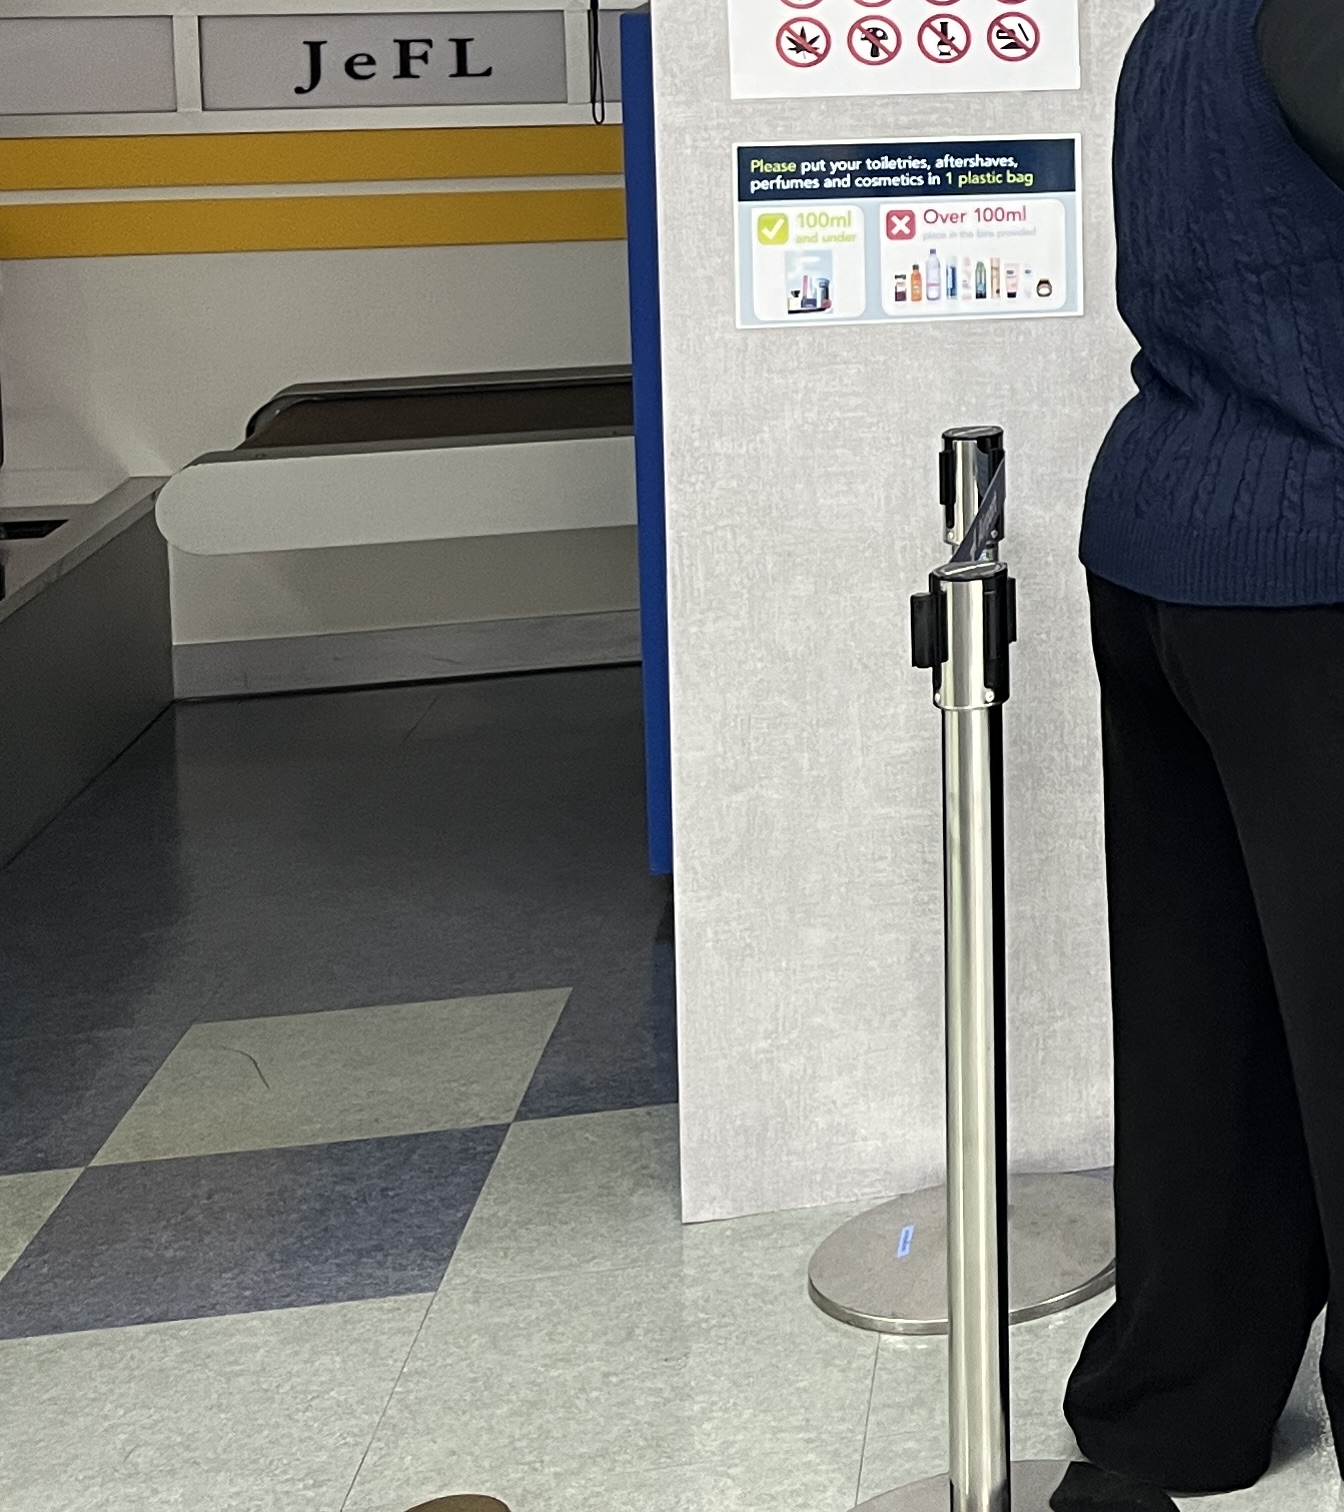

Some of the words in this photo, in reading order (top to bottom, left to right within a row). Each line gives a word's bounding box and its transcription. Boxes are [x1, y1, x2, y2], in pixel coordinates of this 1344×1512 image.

[750, 160, 797, 173] Please
[801, 160, 826, 175] put
[830, 160, 861, 174] your
[866, 156, 931, 170] toiletries,
[935, 155, 1018, 169] aftershaves,
[750, 176, 819, 193] perfumes
[823, 174, 851, 188] and
[855, 173, 923, 187] cosmetics
[928, 172, 941, 185] in
[945, 172, 953, 184] 1
[958, 171, 1003, 187] plastic
[1006, 170, 1034, 186] bag
[798, 211, 852, 228] 100ml
[924, 209, 967, 224] Over
[975, 206, 1026, 222] 100ml
[796, 233, 818, 244] and
[823, 232, 857, 243] under
